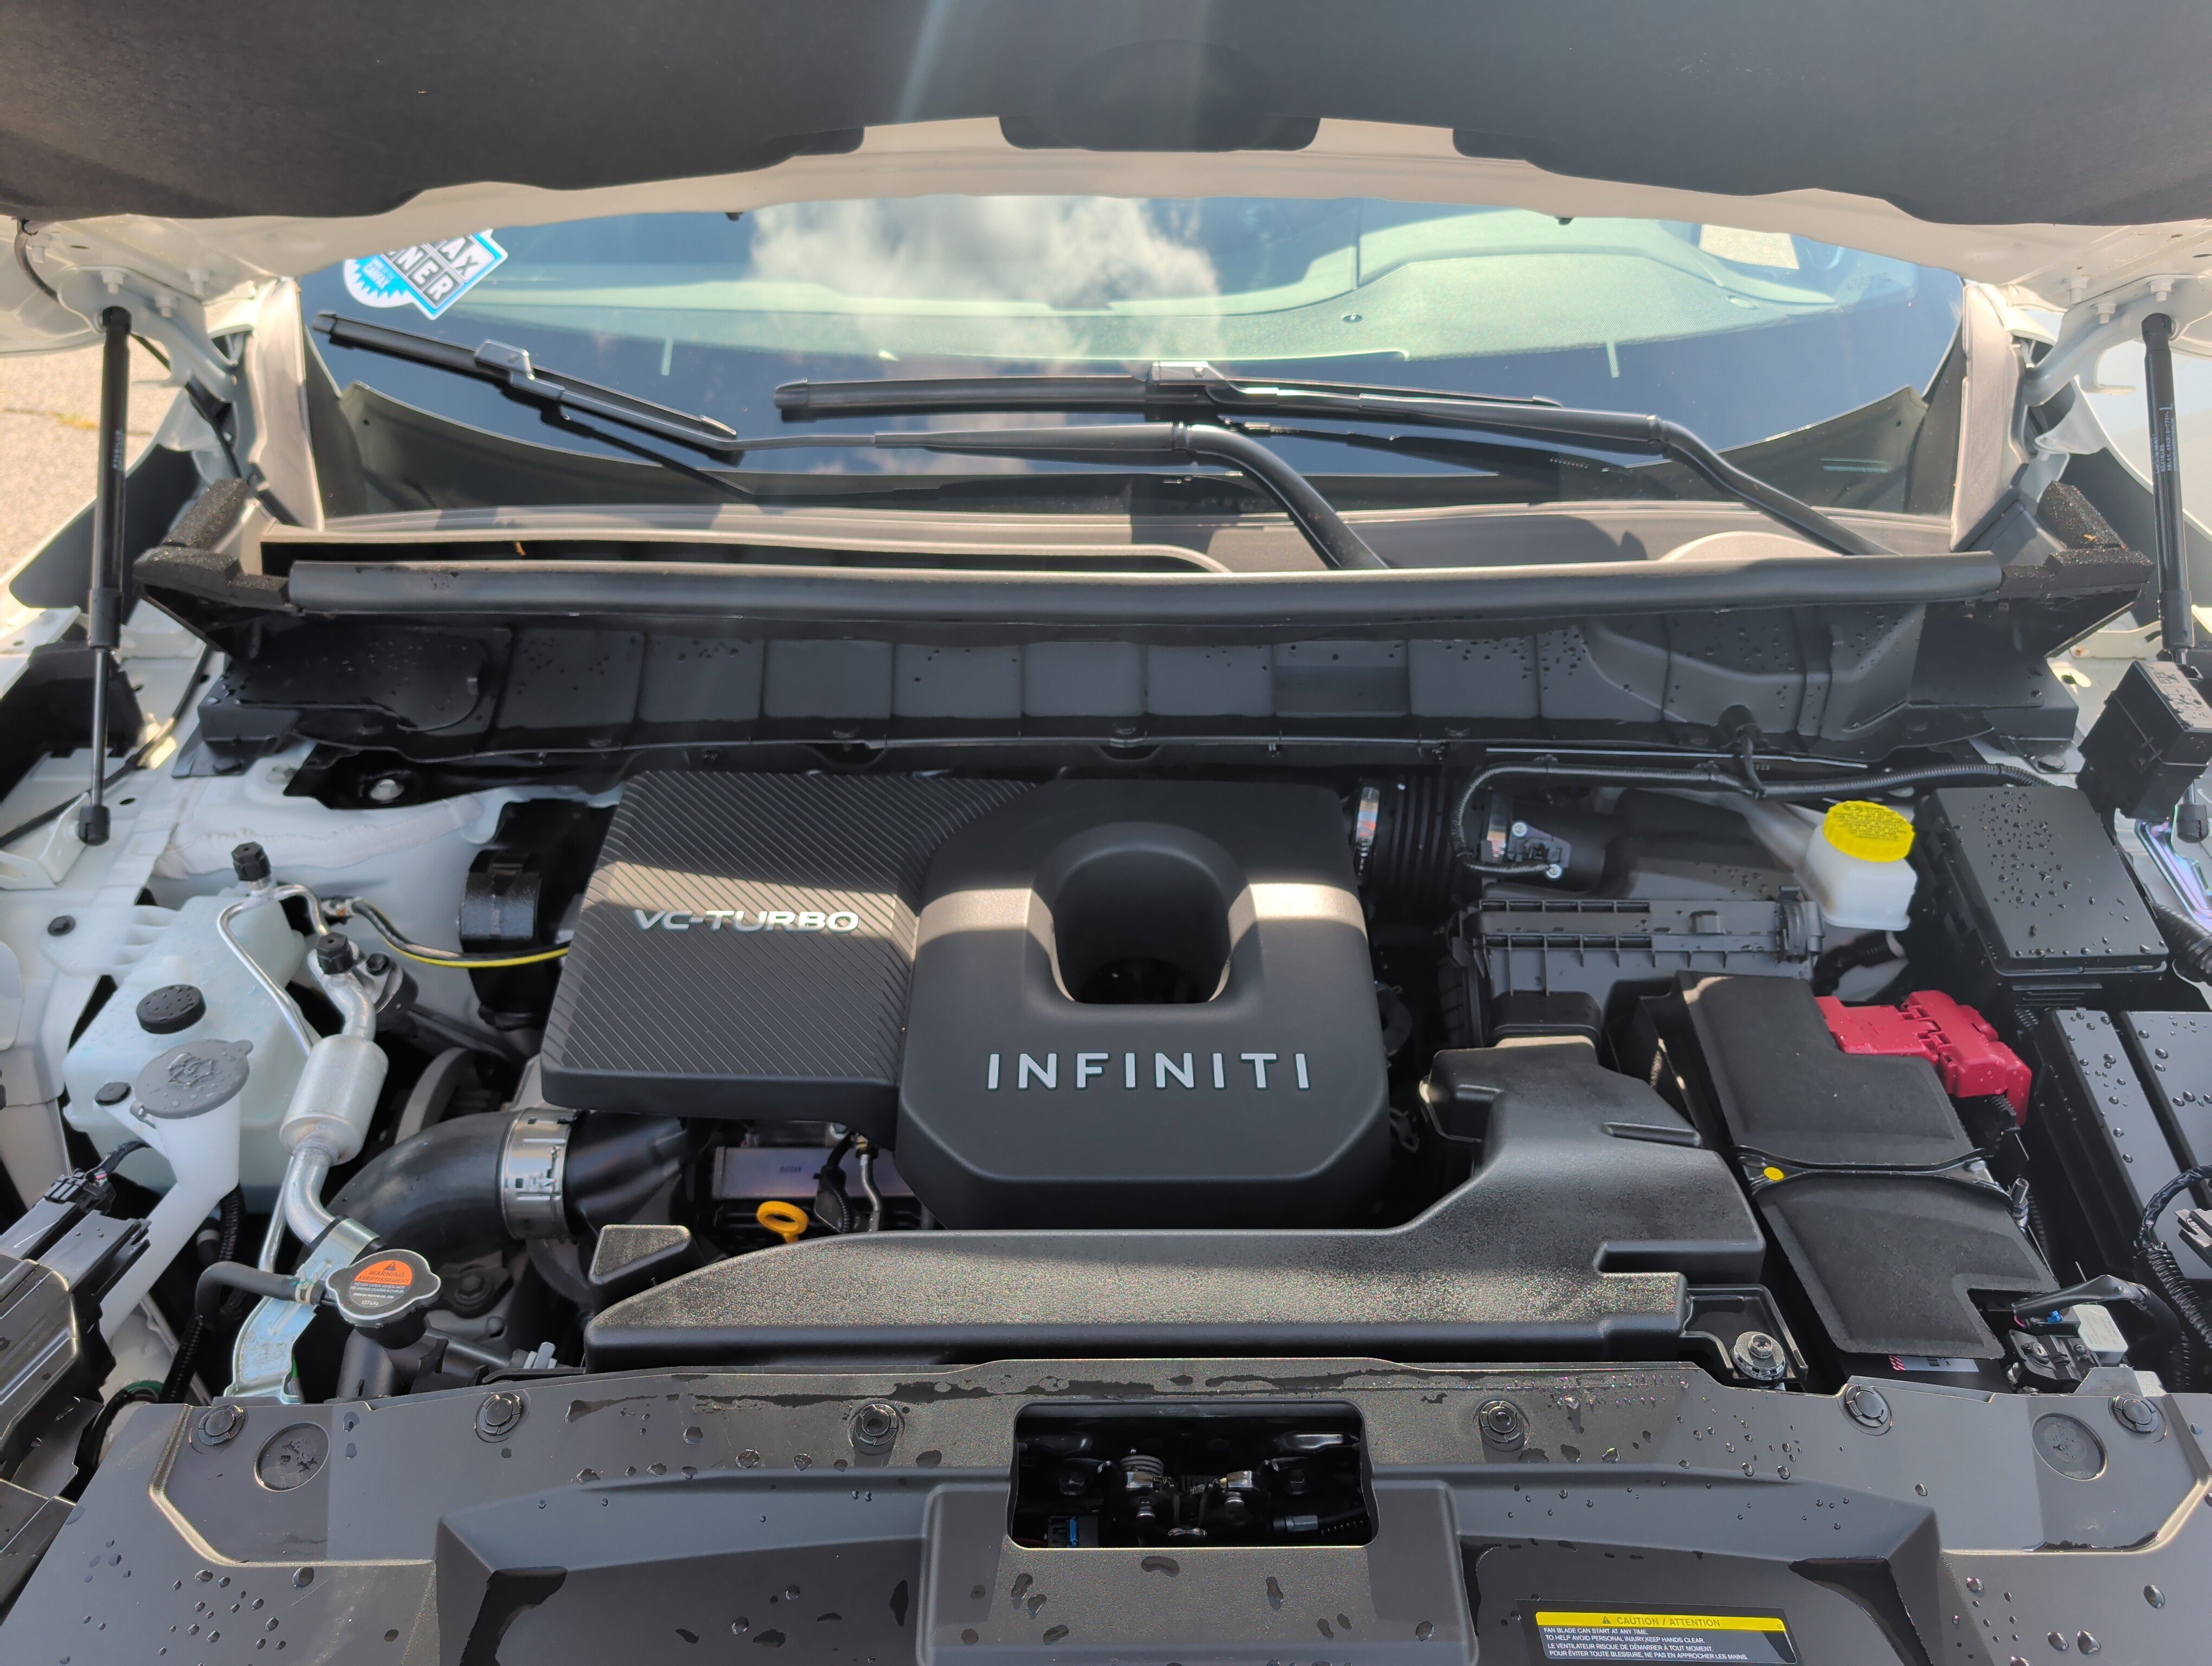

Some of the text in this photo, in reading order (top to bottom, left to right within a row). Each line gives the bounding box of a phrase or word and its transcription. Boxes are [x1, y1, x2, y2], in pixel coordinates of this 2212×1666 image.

[387, 245, 454, 302] NER
[633, 909, 859, 933] VC-TURBO
[987, 1053, 1309, 1091] INFINITI
[358, 1275, 409, 1284] AVERTISSEMENT
[1617, 1617, 1659, 1625] CAUTION
[1670, 1618, 1721, 1627] ATTENTION
